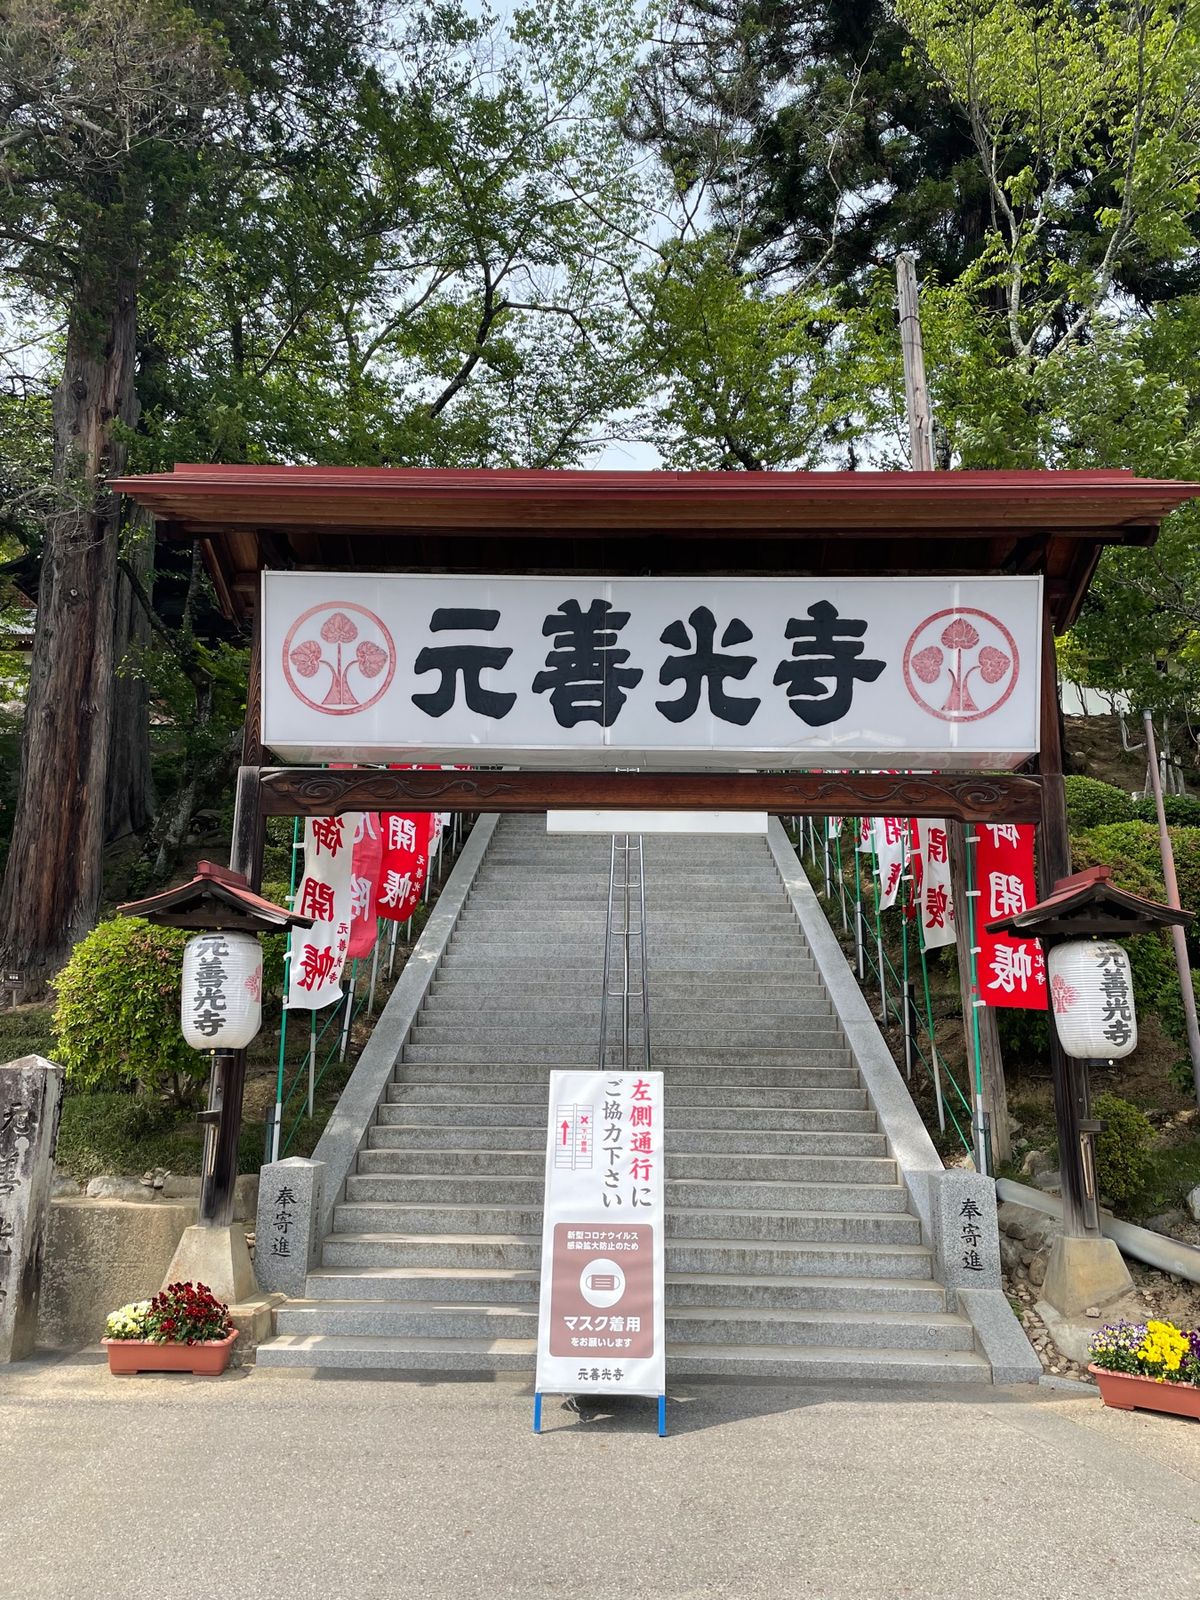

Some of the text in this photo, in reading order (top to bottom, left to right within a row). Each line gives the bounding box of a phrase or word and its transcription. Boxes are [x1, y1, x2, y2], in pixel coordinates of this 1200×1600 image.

[411, 598, 886, 729] 元善光寺
[193, 935, 229, 1037] 元善光寺
[1095, 945, 1132, 1047] 元善光寺
[602, 1078, 624, 1209] ご協力下さい
[629, 1078, 654, 1208] 左側通行に
[270, 1186, 298, 1258] 奉寄進
[566, 1241, 639, 1251] 感染拡大防止のため
[567, 1230, 639, 1240] 新型コロナウイルス
[958, 1198, 985, 1272] 奉寄進
[563, 1315, 641, 1333] マスク着用
[570, 1336, 633, 1348] をお願いします
[576, 1367, 625, 1382] 元善光寺
